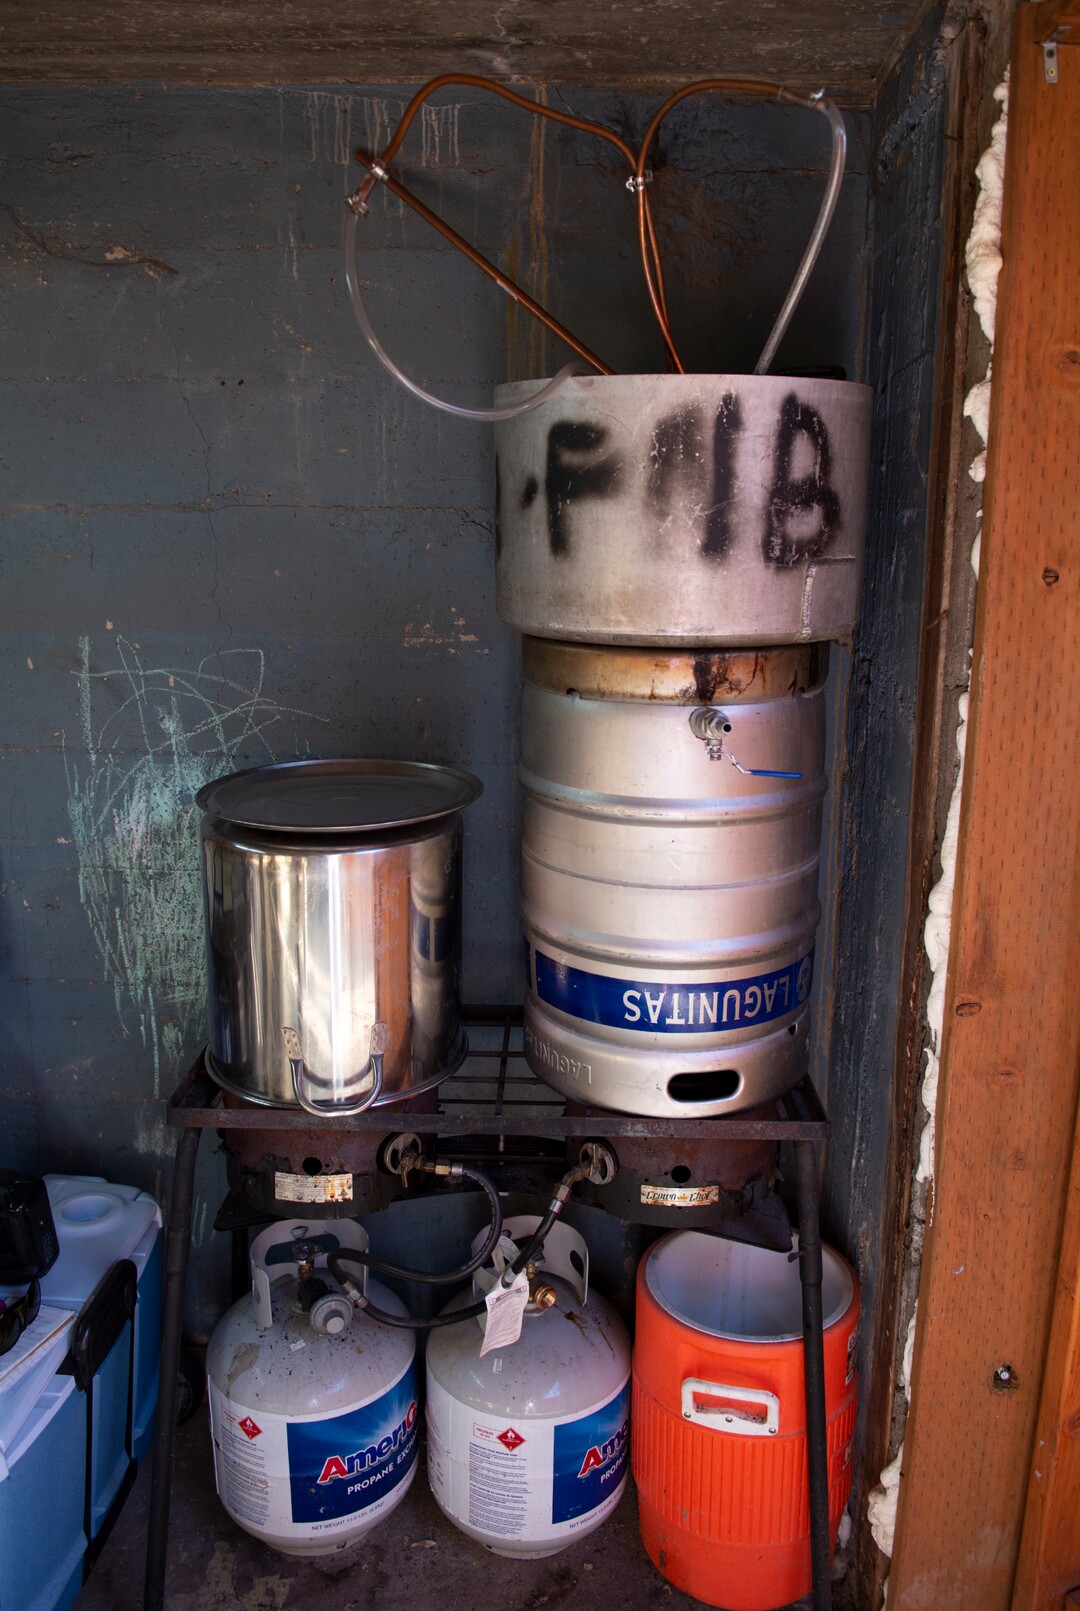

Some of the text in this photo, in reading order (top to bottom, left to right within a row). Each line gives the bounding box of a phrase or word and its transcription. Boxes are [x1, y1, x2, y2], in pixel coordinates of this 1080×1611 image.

[622, 975, 790, 1025] LAGUNITAS
[646, 1190, 677, 1201] Crown
[316, 1400, 417, 1485] AmeriG
[347, 1463, 394, 1495] PROPANE
[323, 1519, 345, 1529] WEIGHT
